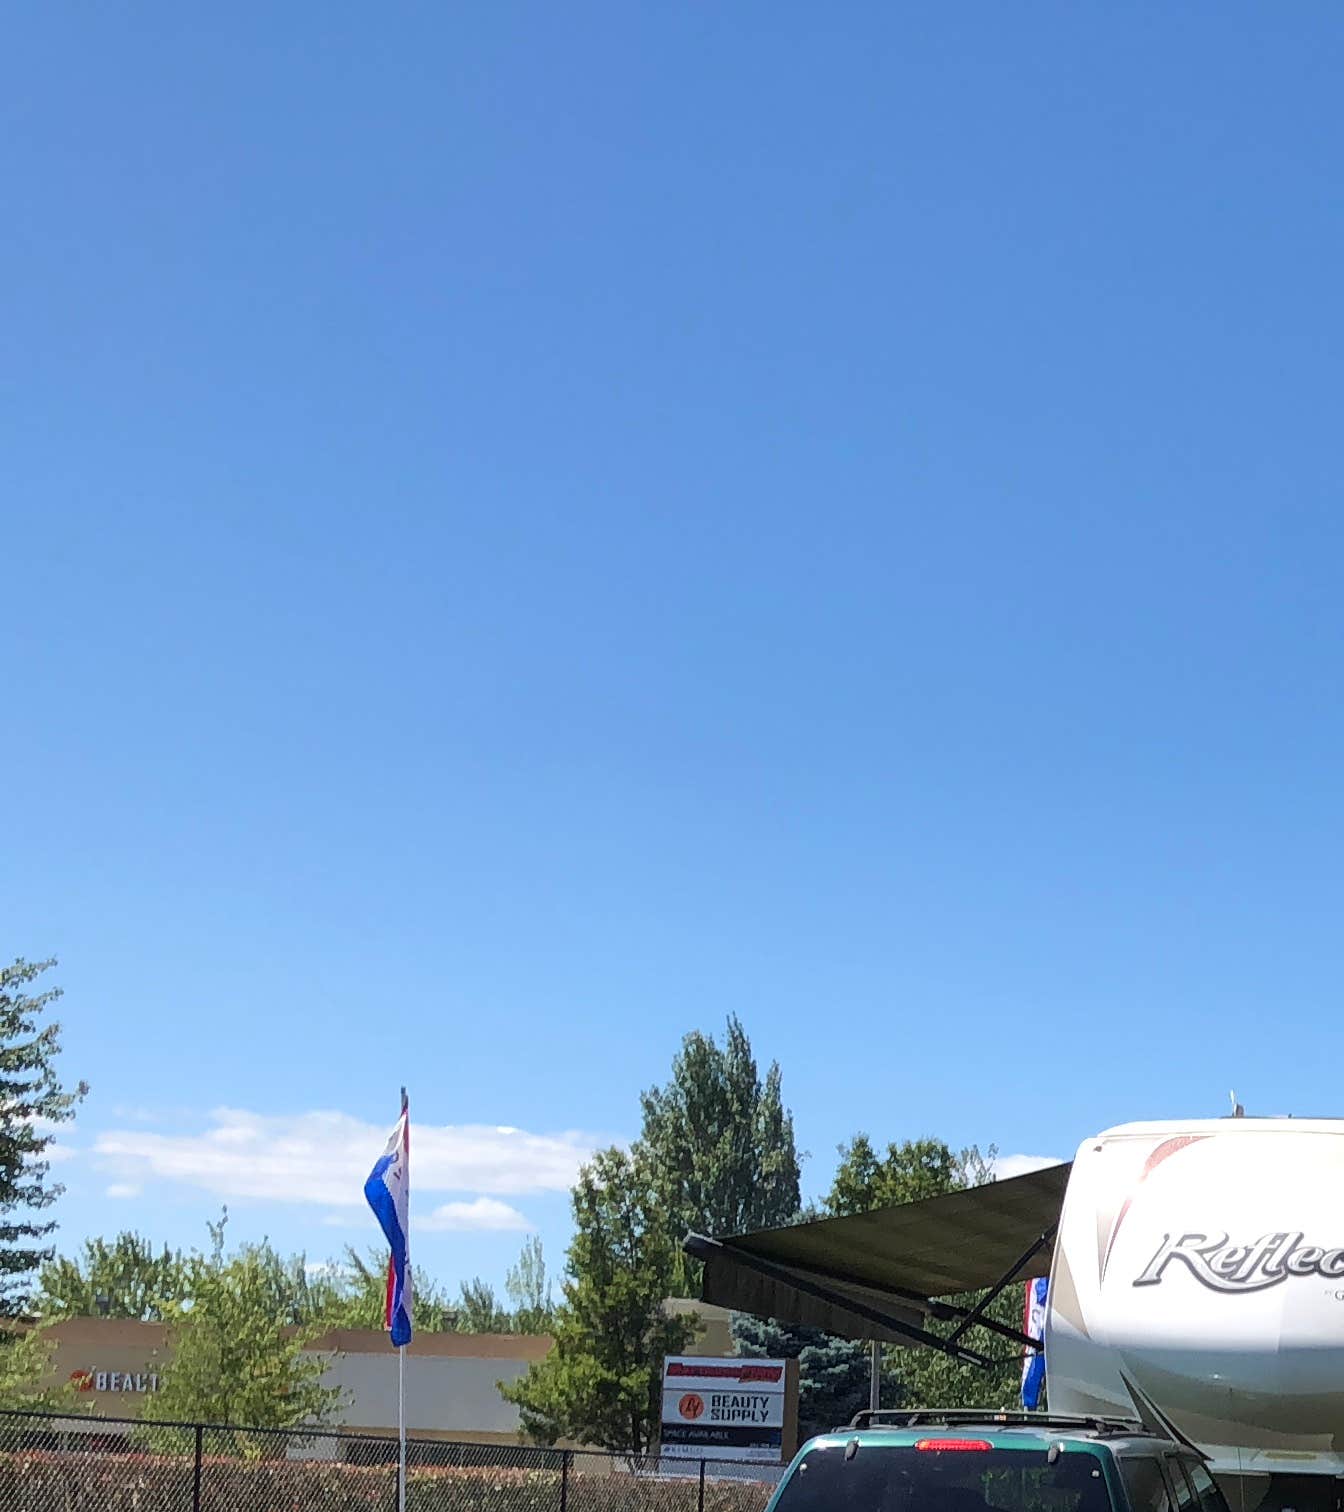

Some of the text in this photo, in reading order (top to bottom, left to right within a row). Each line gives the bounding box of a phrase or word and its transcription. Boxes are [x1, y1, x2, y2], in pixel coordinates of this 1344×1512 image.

[95, 1371, 161, 1392] BEAUT
[711, 1394, 769, 1409] BEAUTY
[710, 1408, 769, 1423] SUPPLY
